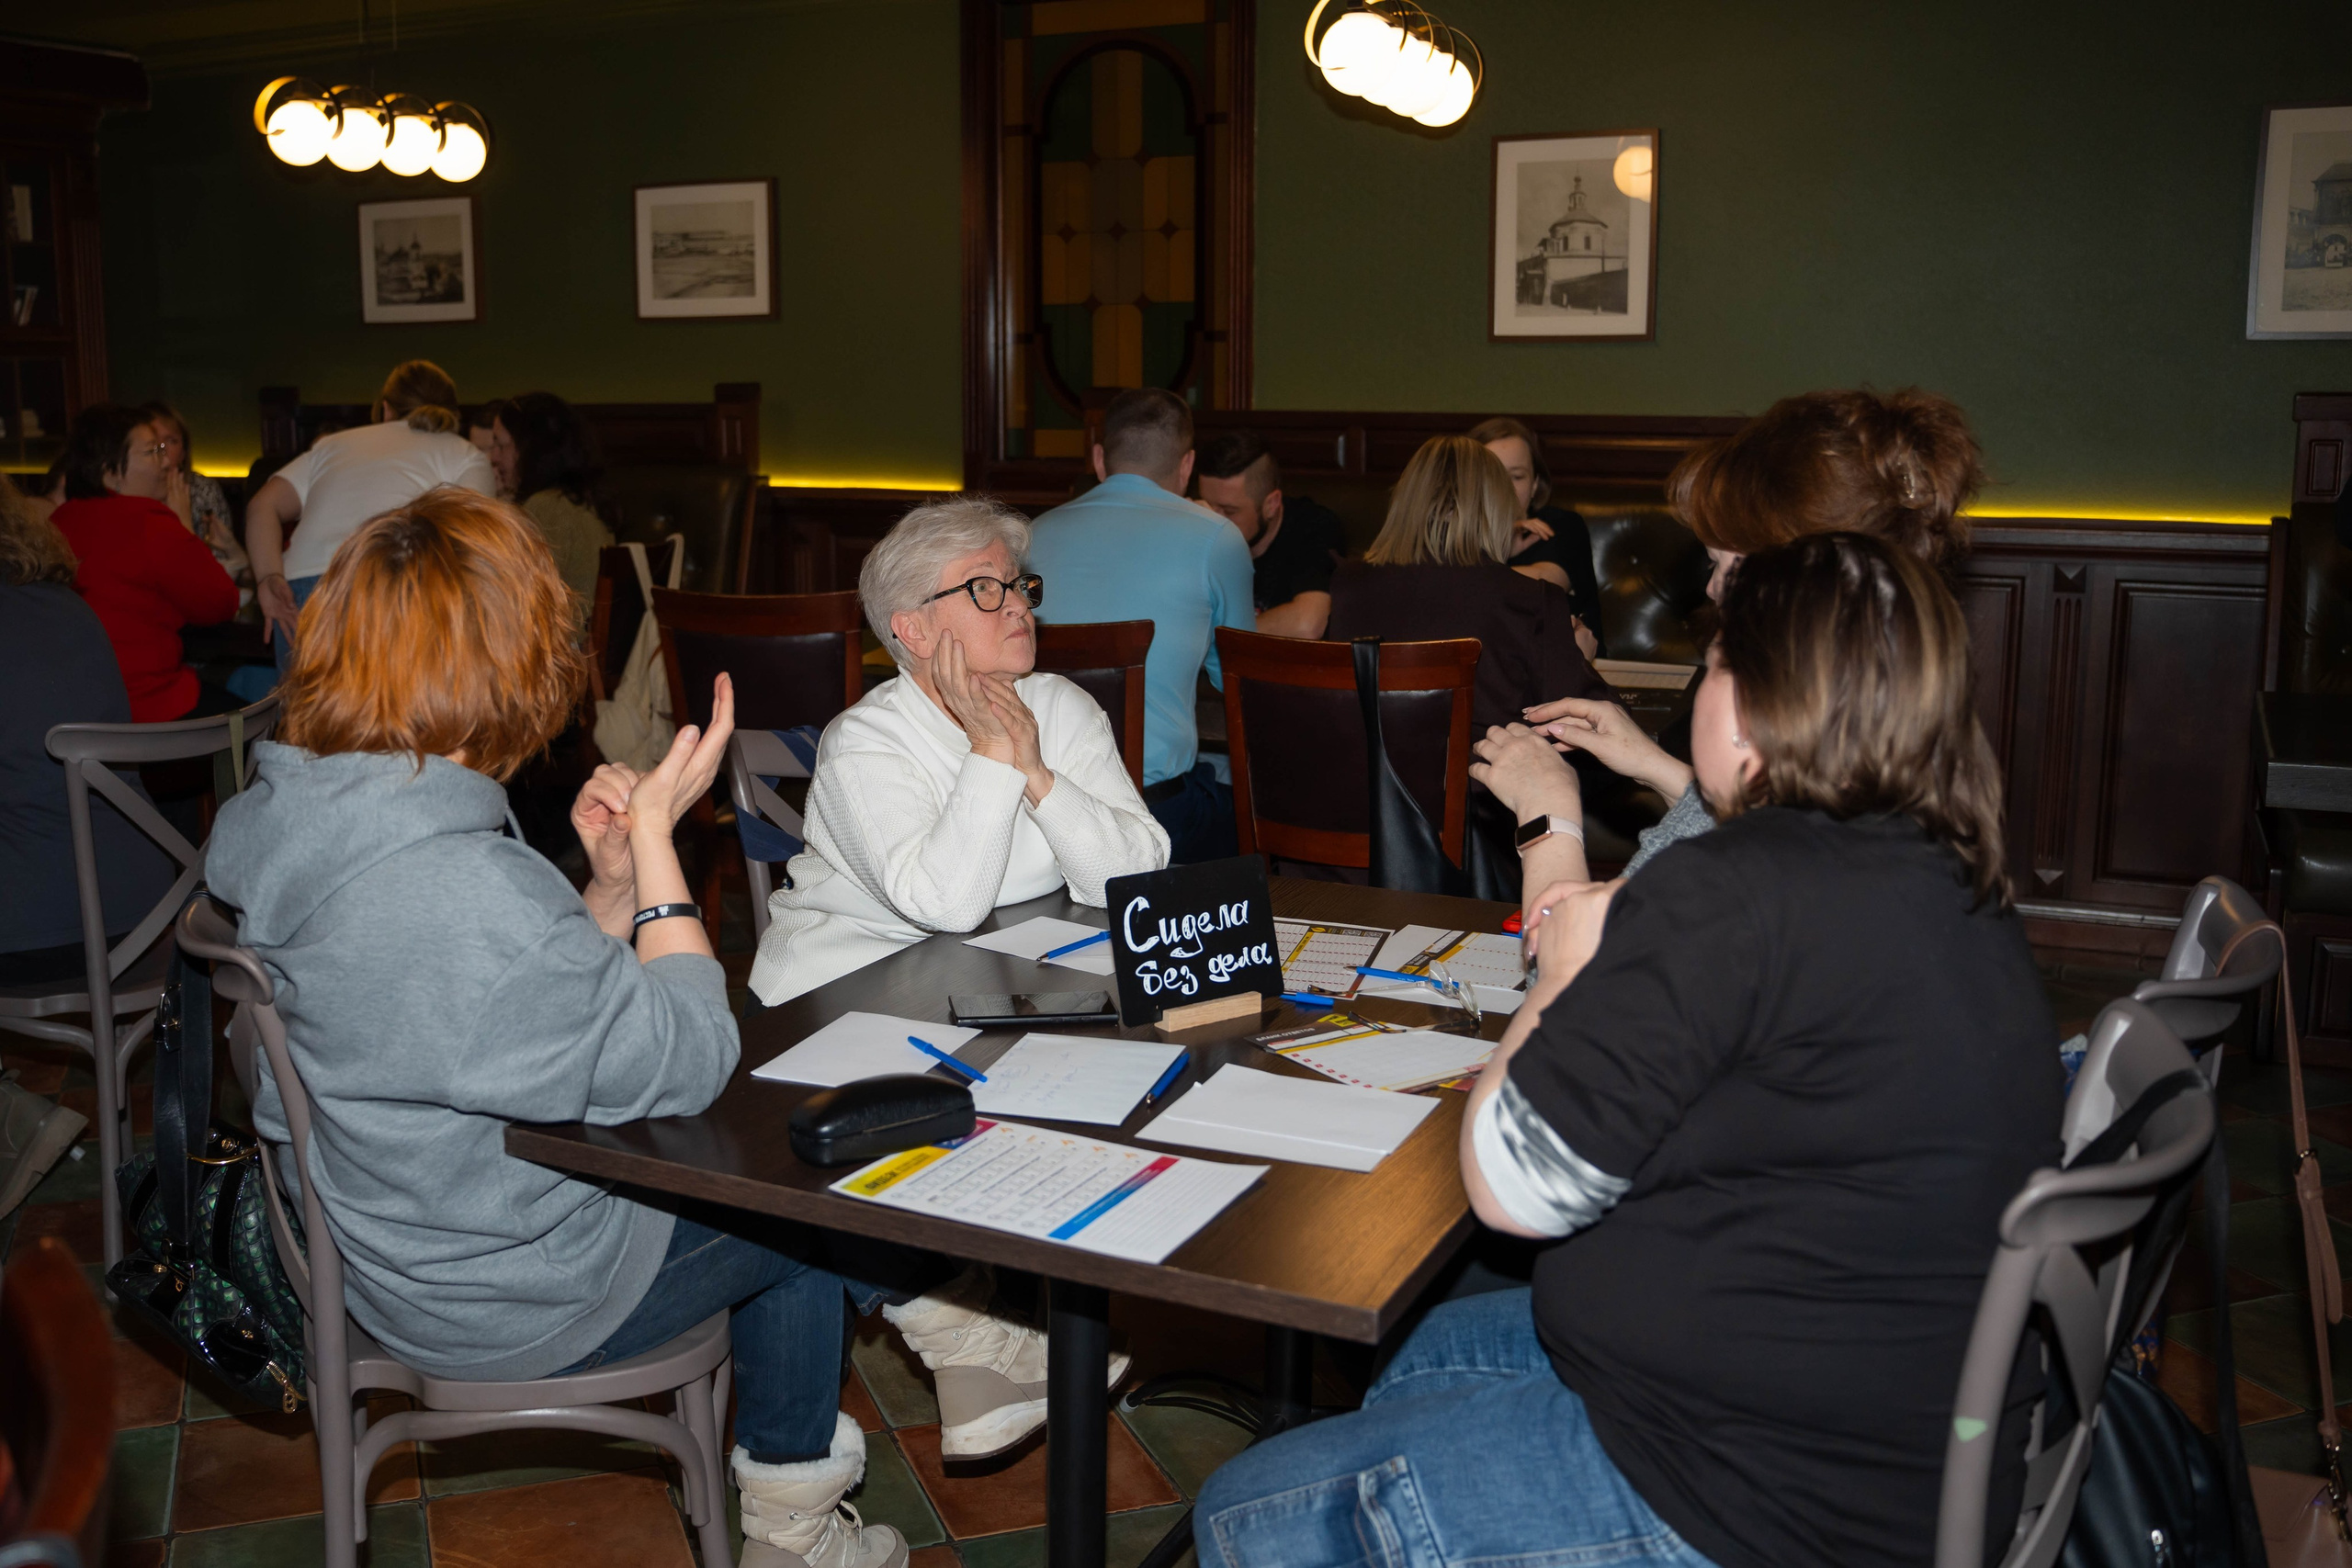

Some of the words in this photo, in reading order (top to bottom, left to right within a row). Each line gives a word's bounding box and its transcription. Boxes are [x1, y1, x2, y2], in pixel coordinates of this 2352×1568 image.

[1124, 897, 1249, 958] Сидела
[1135, 960, 1199, 995] без
[1207, 942, 1272, 983] дела
